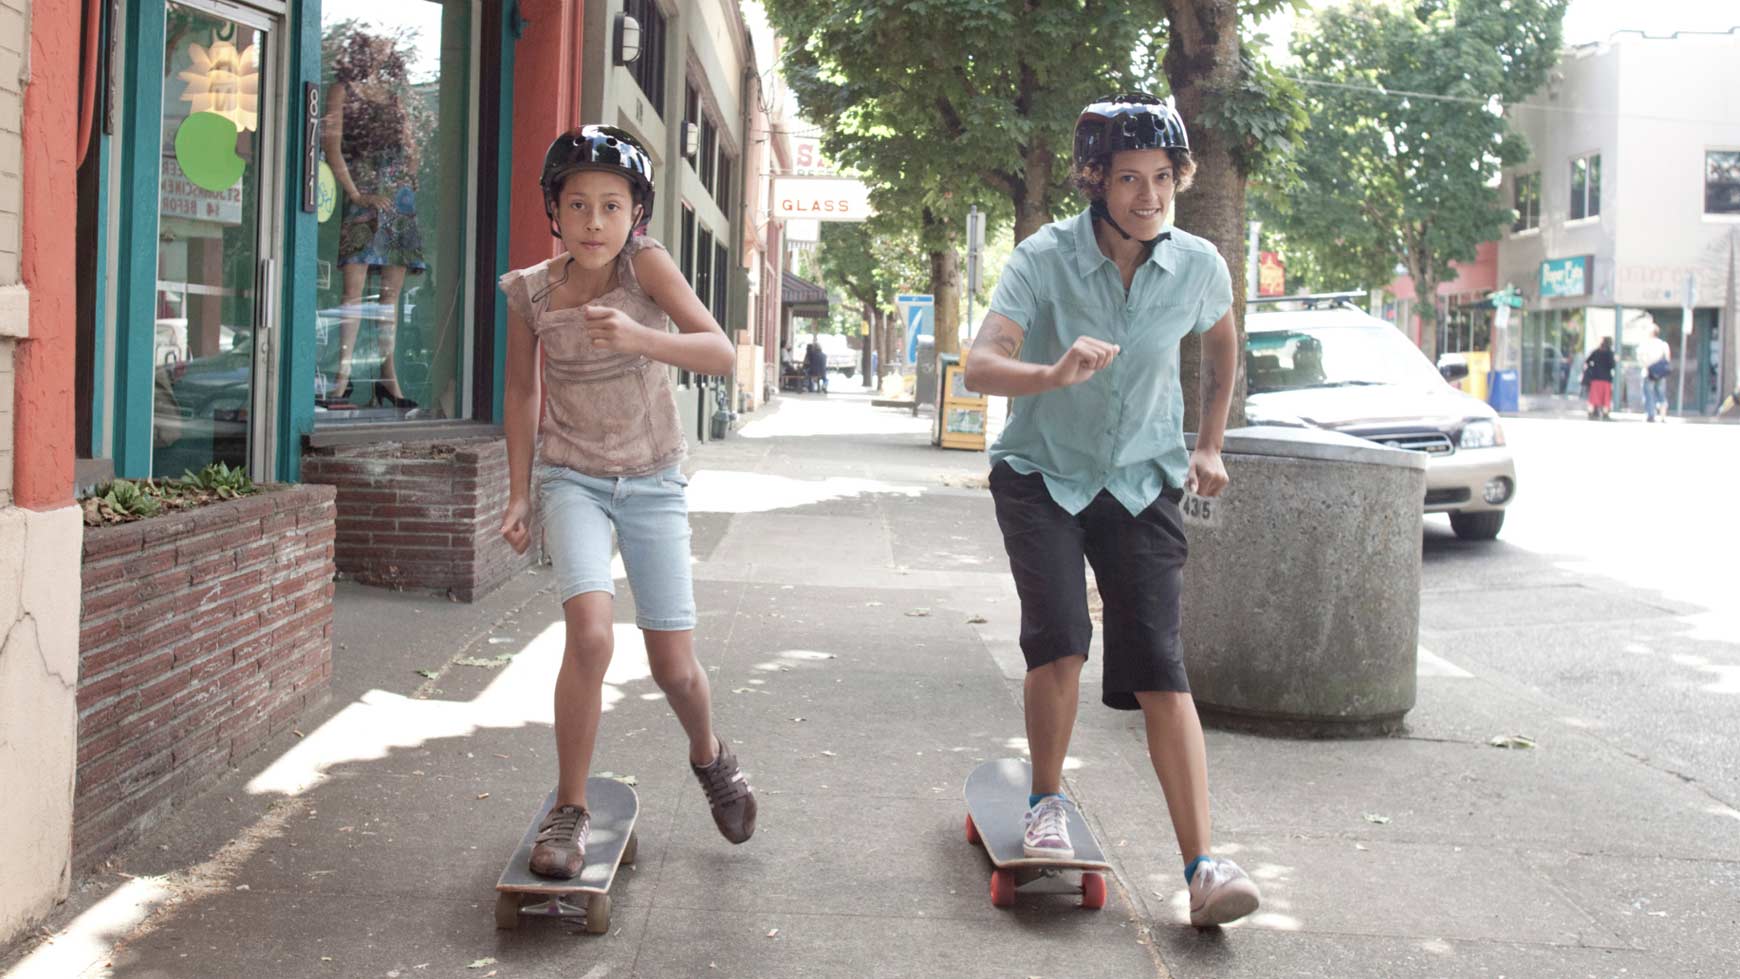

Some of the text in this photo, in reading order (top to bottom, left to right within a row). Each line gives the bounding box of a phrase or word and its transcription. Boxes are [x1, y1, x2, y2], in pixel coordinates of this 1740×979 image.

[309, 89, 319, 206] 8711
[782, 199, 849, 212] GLASS
[1183, 495, 1210, 519] 435
